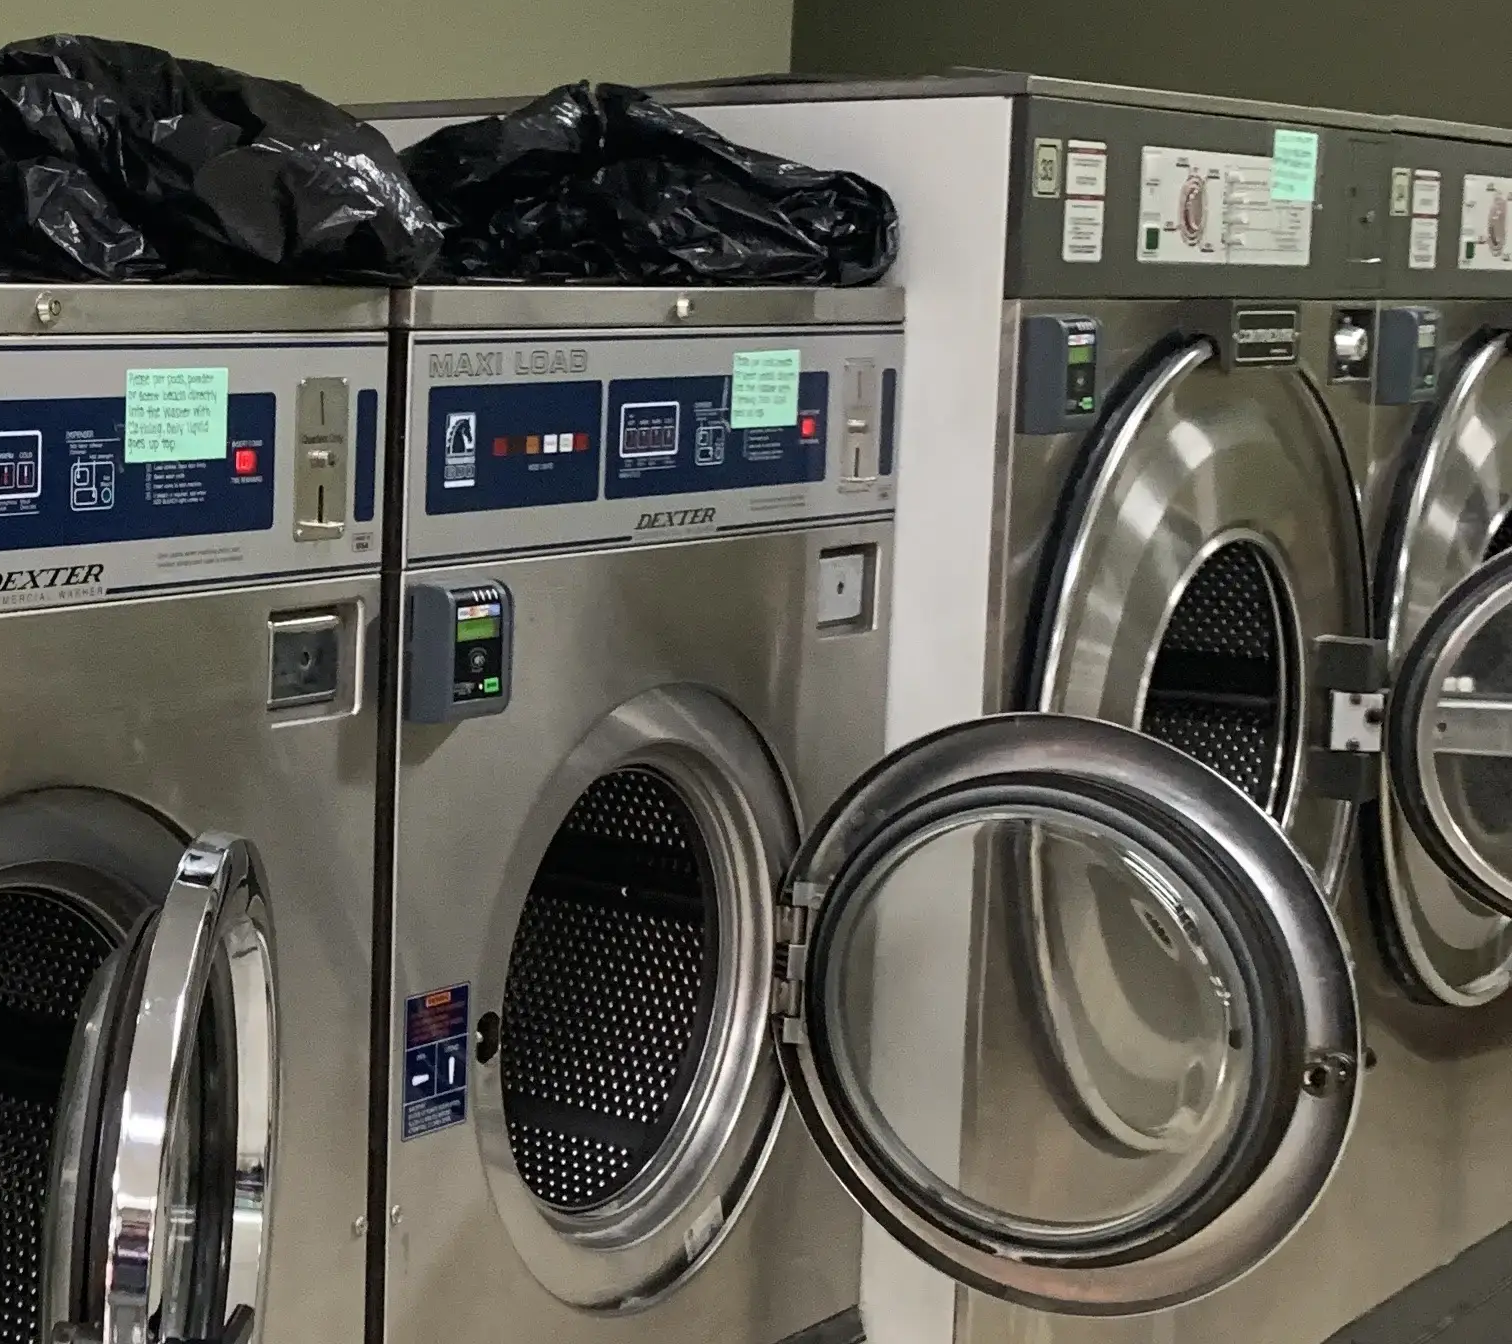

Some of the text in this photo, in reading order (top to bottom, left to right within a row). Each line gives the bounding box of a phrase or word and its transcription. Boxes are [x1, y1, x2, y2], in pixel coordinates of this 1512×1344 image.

[429, 349, 587, 378] MAXI LOAD
[635, 507, 716, 530] DEXTER
[59, 586, 103, 599] WASHER
